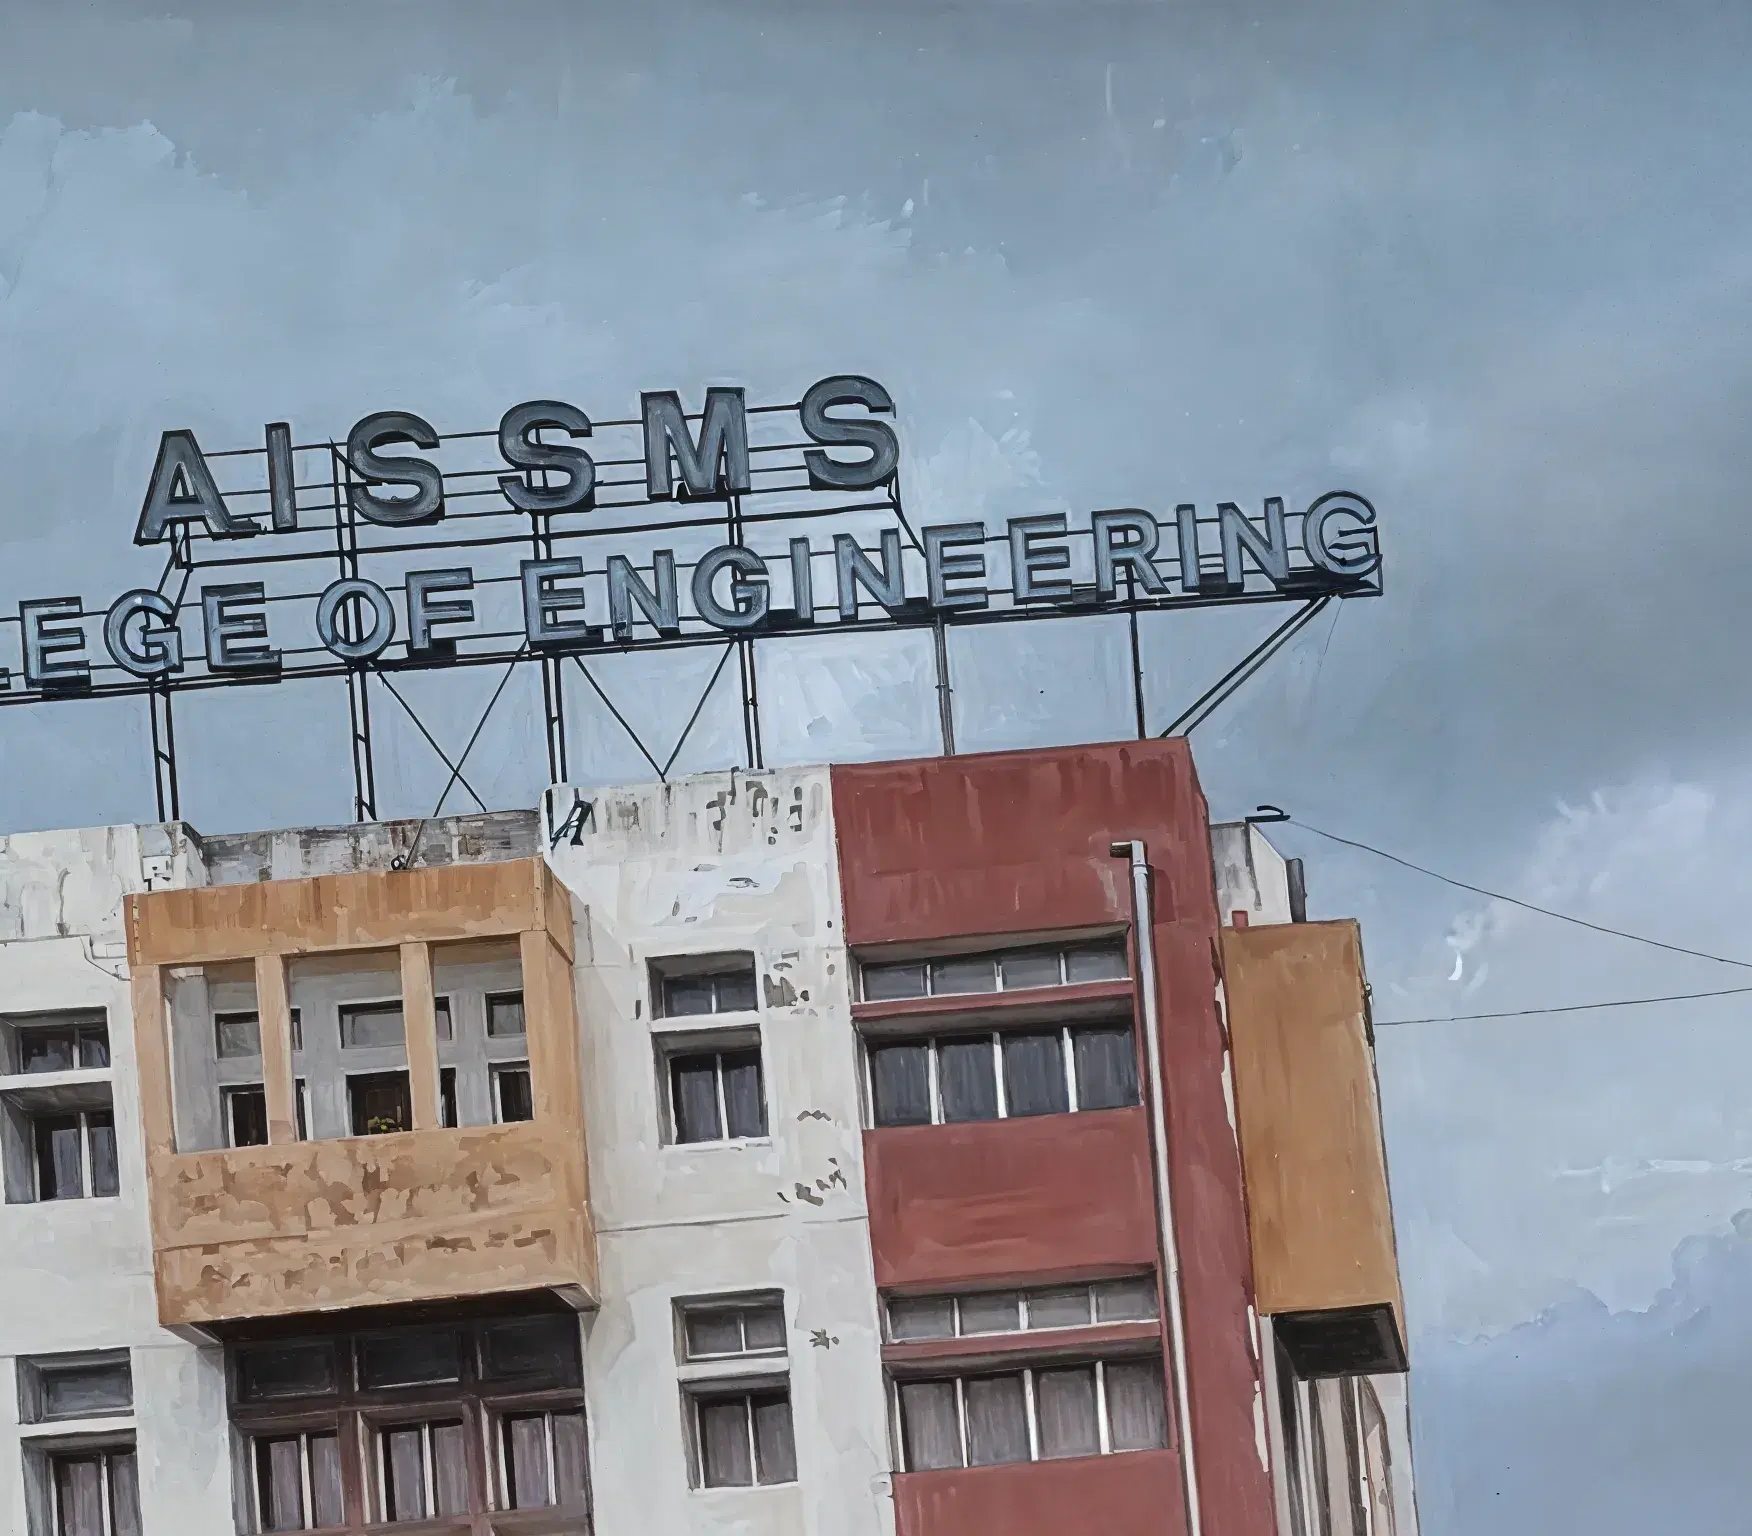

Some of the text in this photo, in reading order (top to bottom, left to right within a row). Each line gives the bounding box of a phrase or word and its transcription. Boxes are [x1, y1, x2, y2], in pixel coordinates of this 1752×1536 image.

[135, 375, 900, 547] AISSMS
[317, 567, 476, 662] OF
[522, 490, 1383, 644] ENGINEERING
